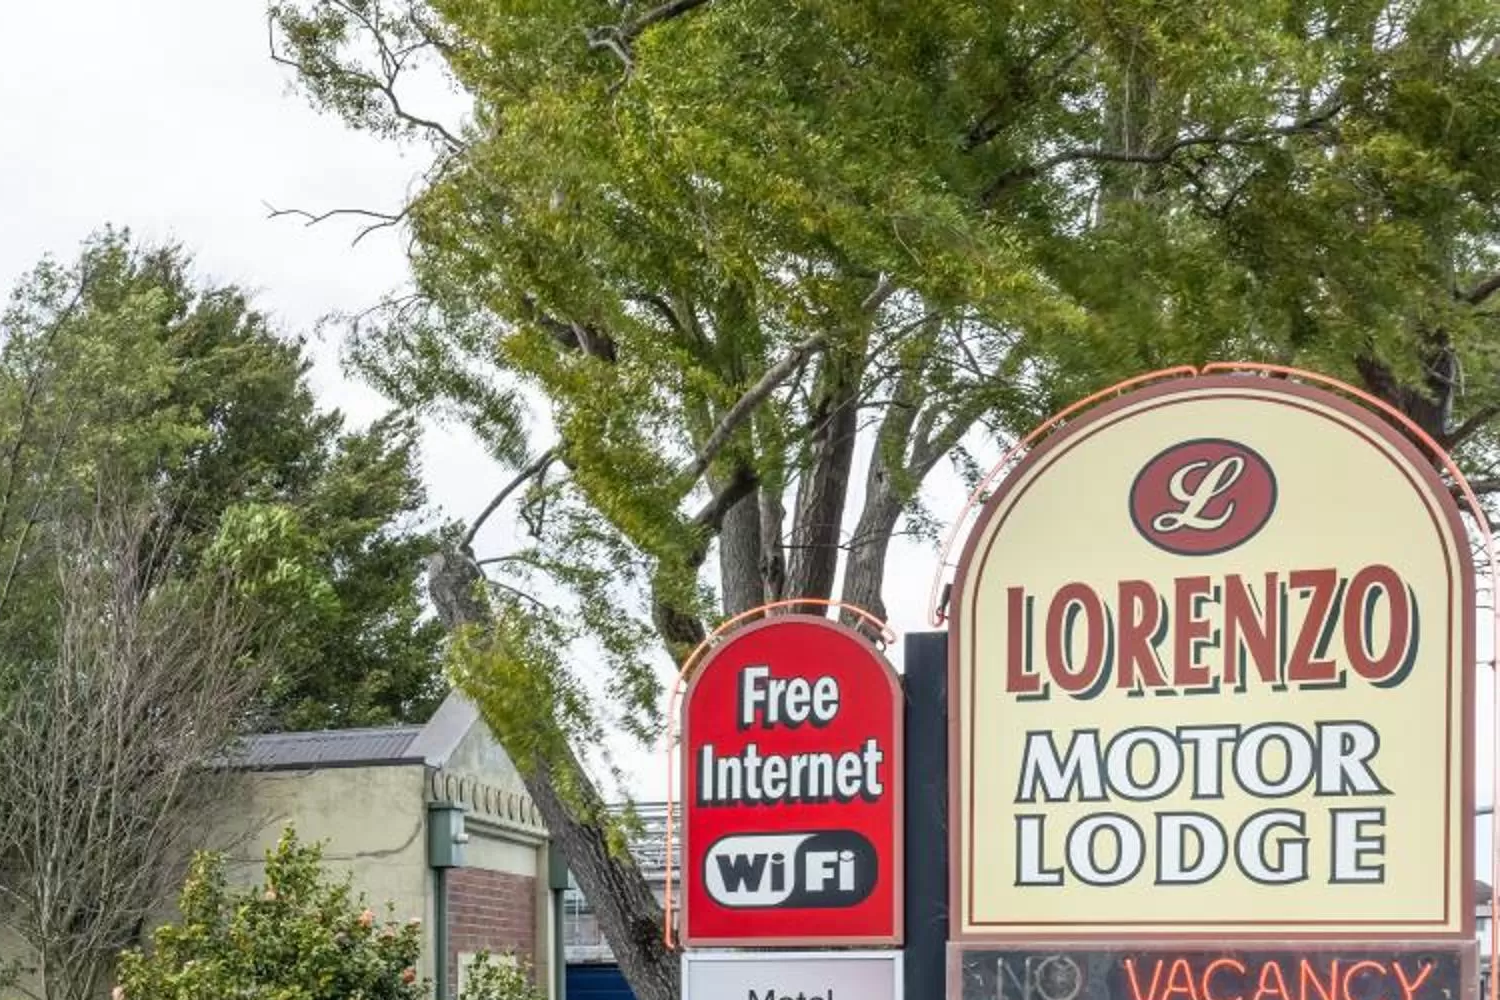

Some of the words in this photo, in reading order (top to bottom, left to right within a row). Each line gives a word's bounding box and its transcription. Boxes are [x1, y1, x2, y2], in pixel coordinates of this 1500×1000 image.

[1005, 564, 1420, 702] LORENZO
[737, 665, 840, 729] Free
[697, 738, 885, 808] Internet
[1013, 719, 1394, 803] MOTOR
[1013, 807, 1388, 887] LODGE
